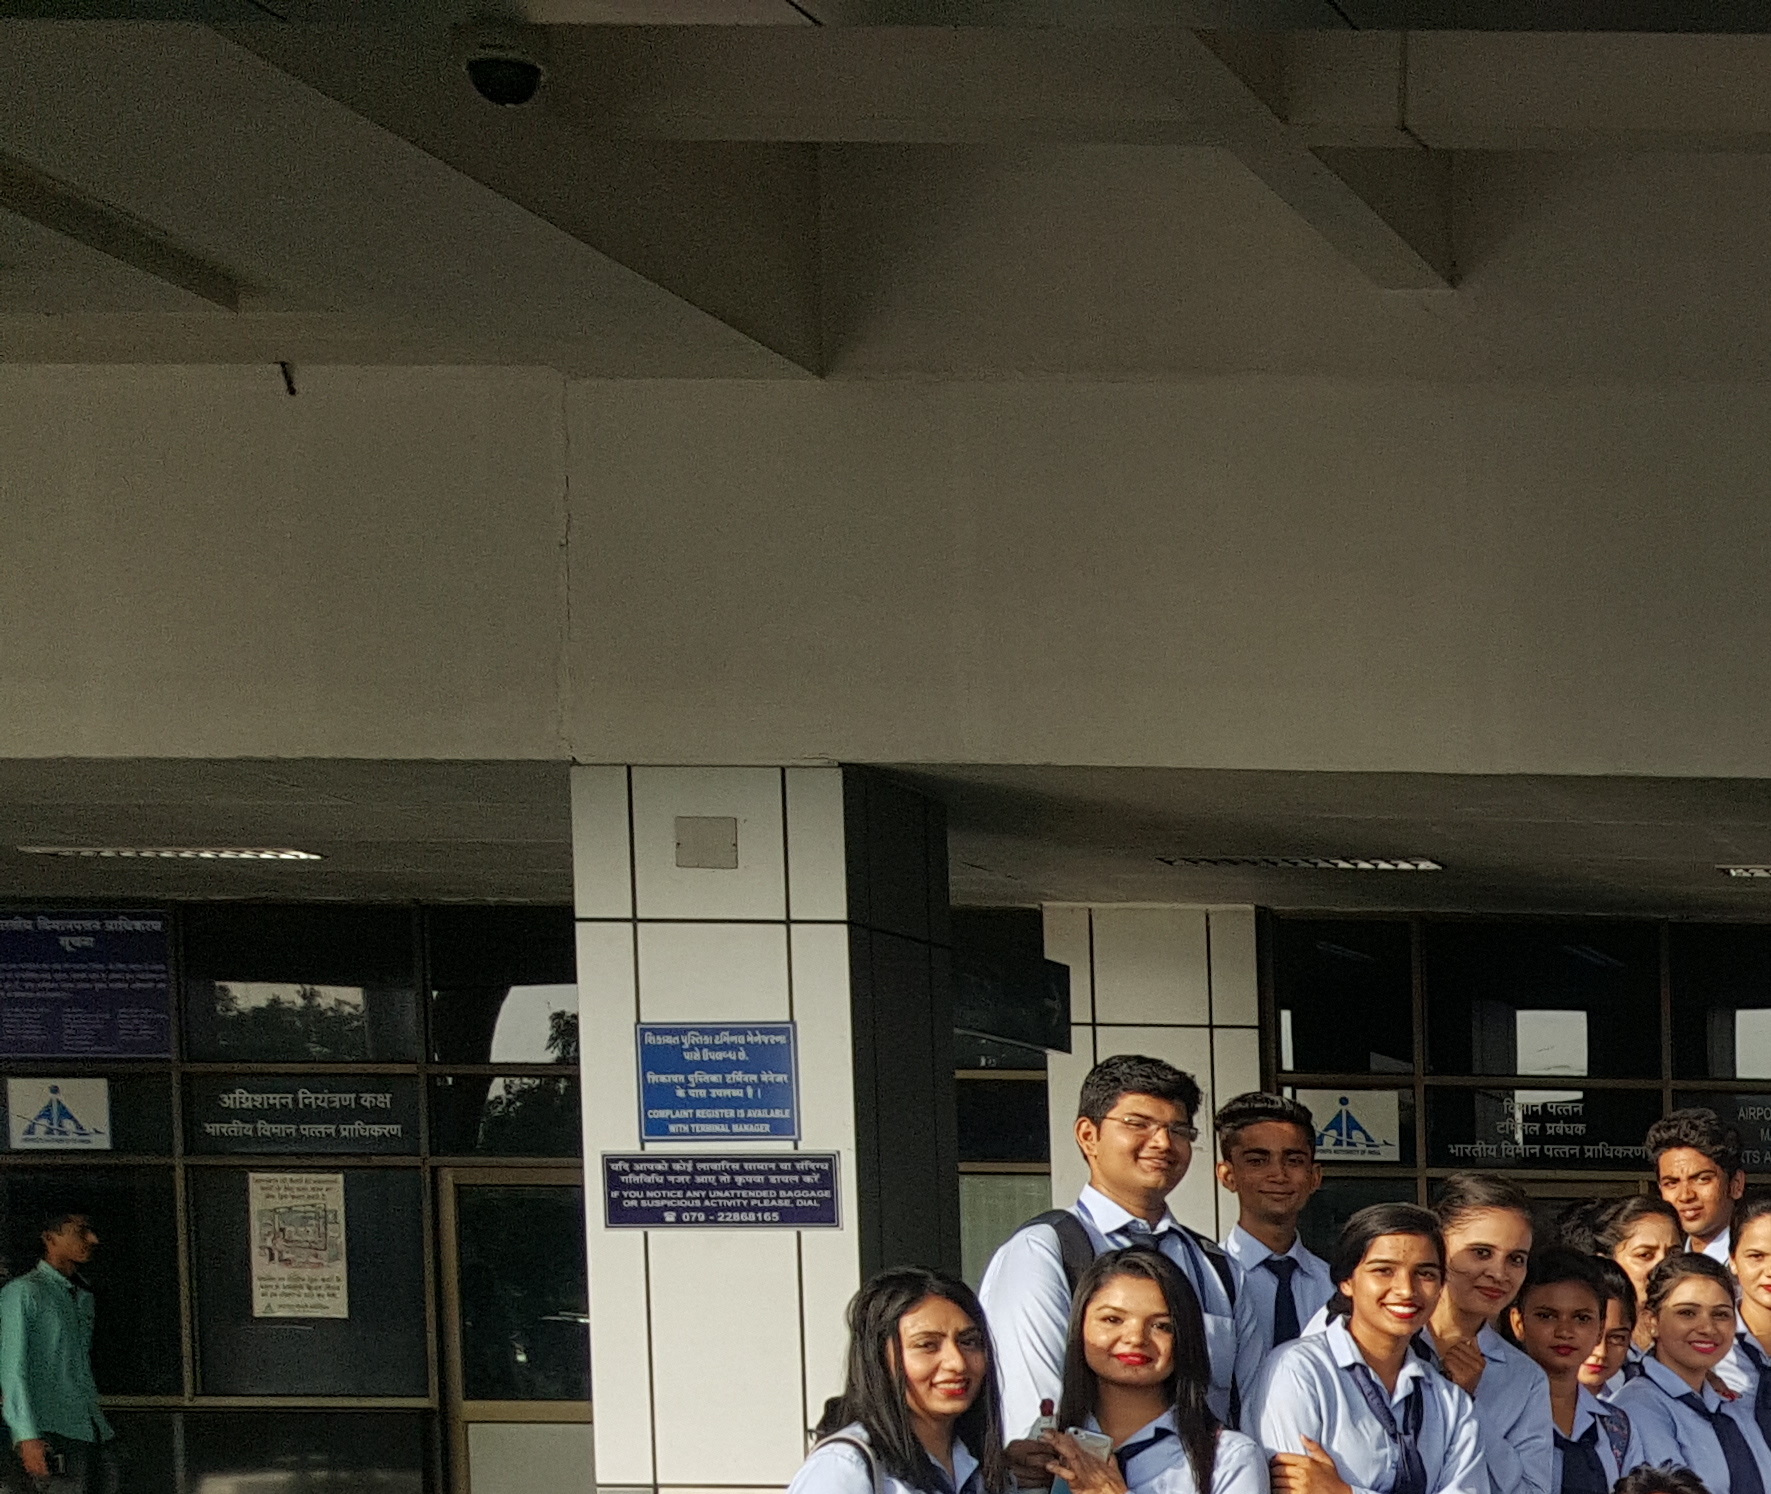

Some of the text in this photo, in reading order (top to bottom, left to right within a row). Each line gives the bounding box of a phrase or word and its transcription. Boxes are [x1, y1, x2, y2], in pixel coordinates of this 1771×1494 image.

[359, 1093, 392, 1109] कक्ष
[647, 1109, 790, 1118] COMPLAINT REGISTER IS AVAILABLE
[1504, 1101, 1542, 1116] विमान
[204, 1120, 253, 1137] भारतीय
[256, 1120, 296, 1137] विमान
[339, 1120, 402, 1138] प्राधिकरण
[668, 1124, 770, 1133] WITH TERMINAL MANAGER
[1448, 1143, 1497, 1158] भारतीय
[1500, 1143, 1540, 1158] विमान
[609, 1161, 630, 1172] यदि
[718, 1172, 731, 1184] तो
[611, 1190, 831, 1198] IF YOU NOTICE ANY UNATTENDED BAGGAGE
[623, 1199, 639, 1207] OR
[640, 1199, 701, 1207] SUSPICIOUS
[703, 1199, 748, 1207] ACTIVITY
[796, 1199, 820, 1207] DIAL
[682, 1213, 705, 1222] 079
